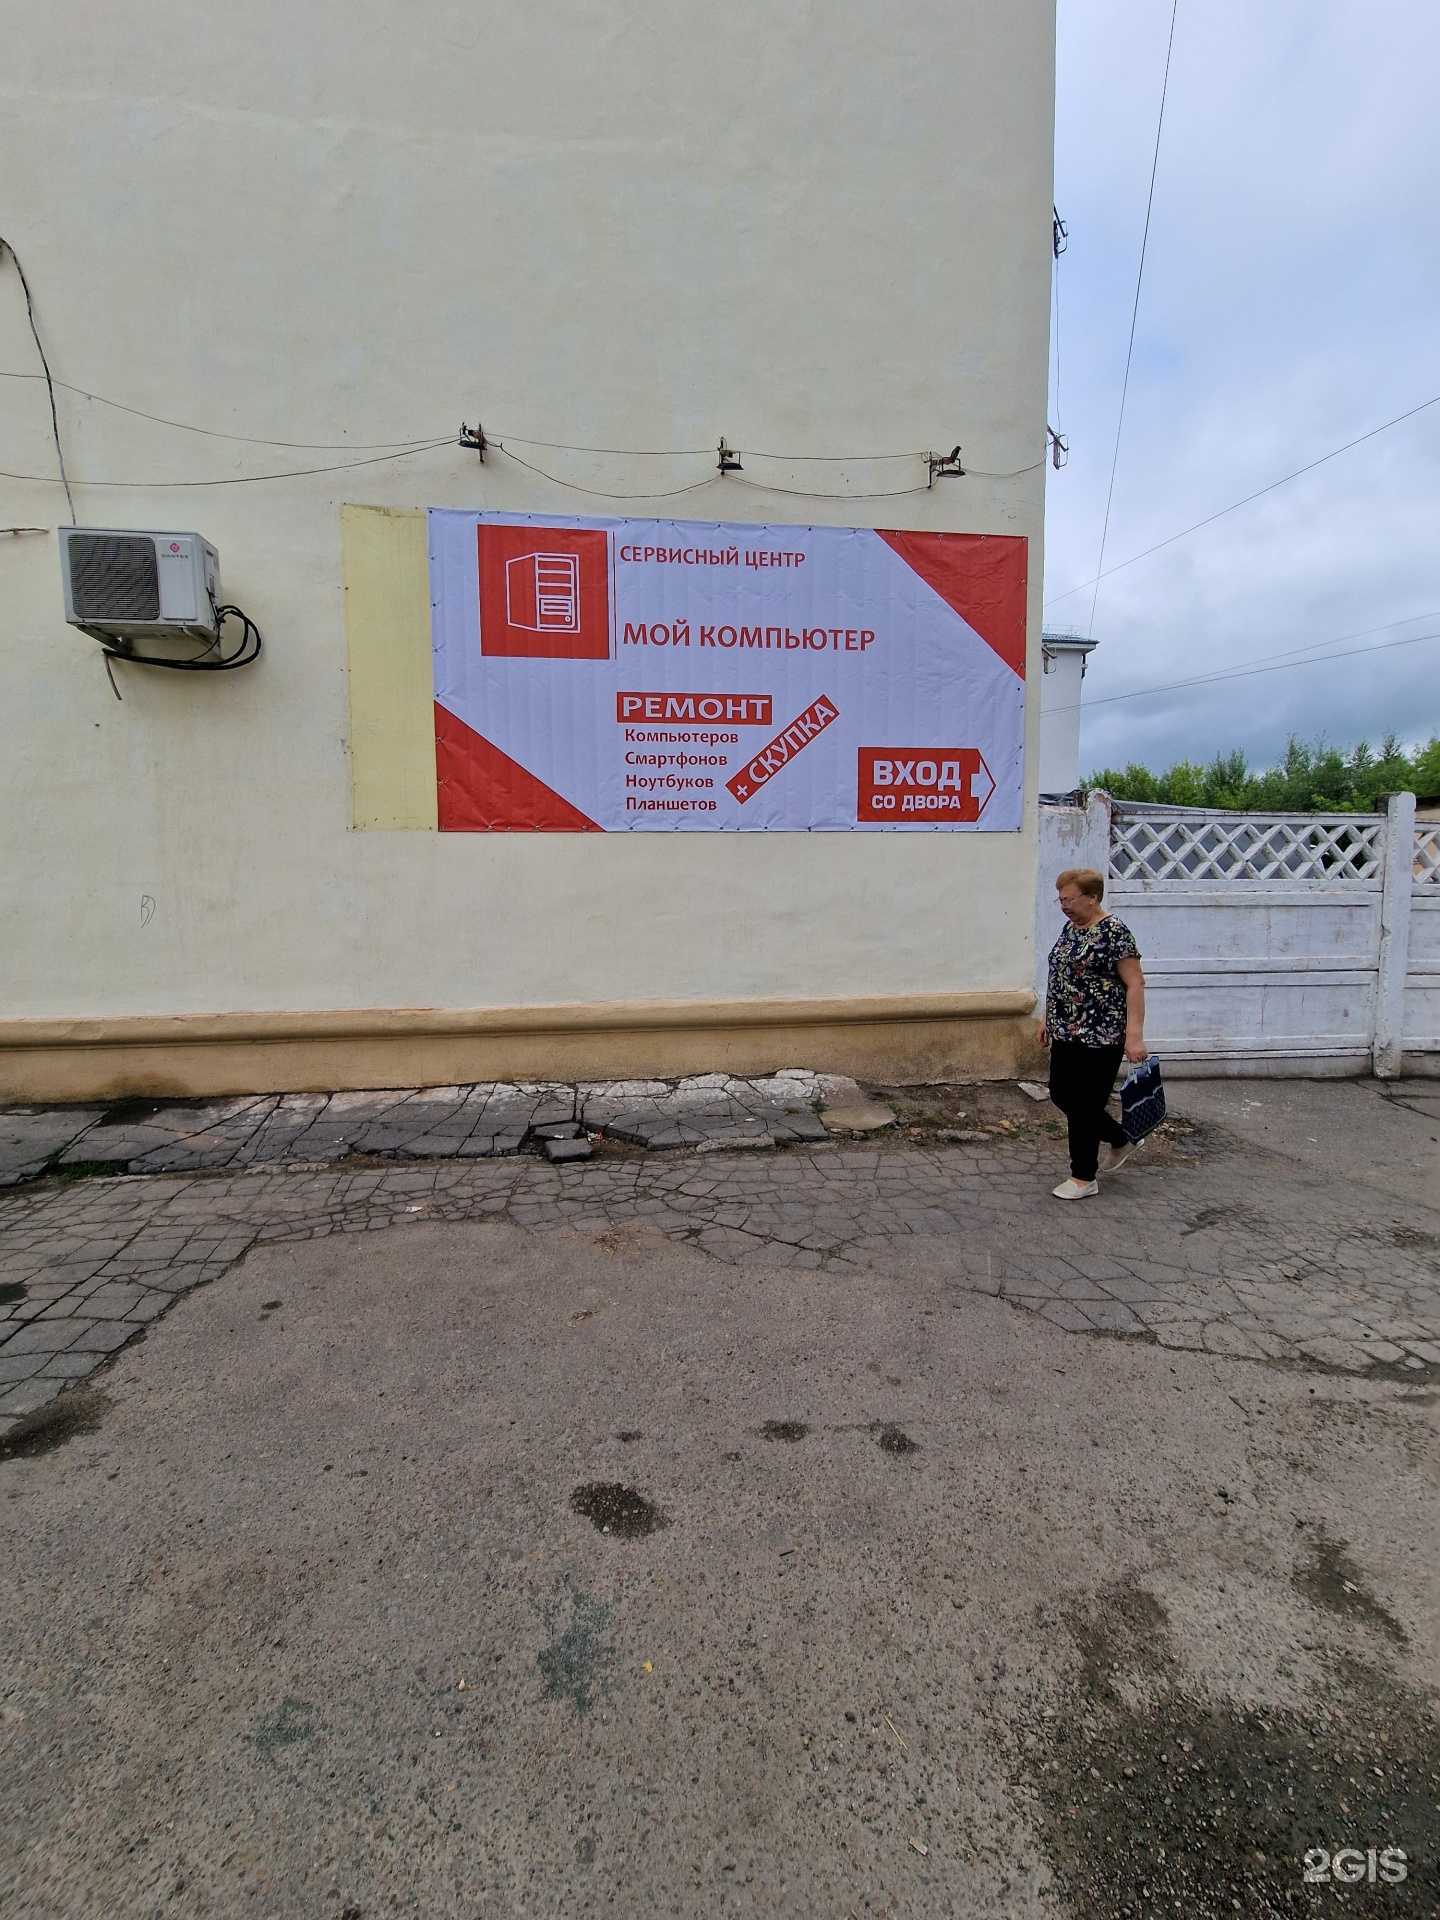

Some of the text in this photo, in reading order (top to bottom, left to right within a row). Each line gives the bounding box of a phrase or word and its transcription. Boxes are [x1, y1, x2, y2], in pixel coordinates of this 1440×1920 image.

[620, 545, 805, 570] СЕРВИСНЫЙ ЦЕНТР
[623, 619, 875, 651] МОЙ КОМПЬЮТЕР
[624, 696, 769, 720] РЕМОНТ
[625, 729, 738, 746] Компьютеров
[749, 703, 835, 783] СКУПКА
[625, 752, 727, 768] Смартфонов
[626, 774, 713, 791] Ноутбуков
[873, 760, 961, 791] ВХОД
[626, 797, 717, 811] Планшетов
[871, 795, 961, 812] СО ДВОРА
